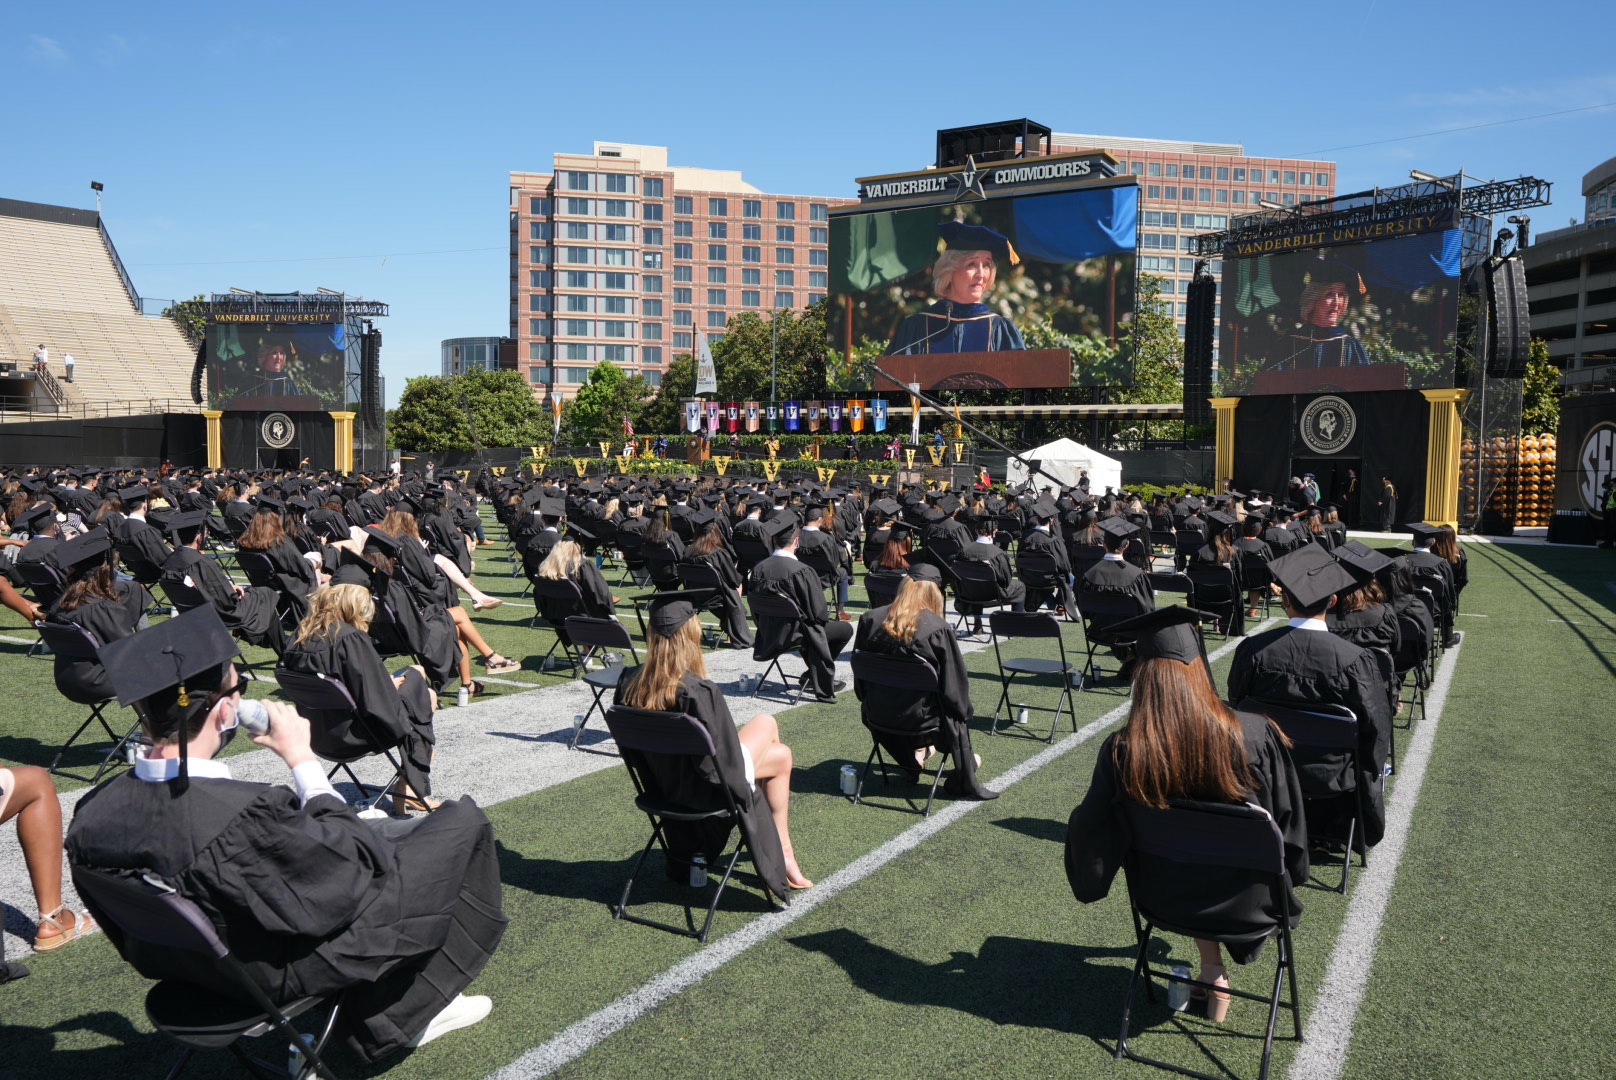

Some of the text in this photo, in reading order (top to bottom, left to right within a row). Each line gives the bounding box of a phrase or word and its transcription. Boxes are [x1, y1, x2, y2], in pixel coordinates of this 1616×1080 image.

[866, 160, 1090, 198] VANDERBILT V COMMODORES
[1236, 216, 1436, 255] VANDERBILT UNIVERSITY
[274, 314, 331, 322] UNIVERSITY
[1582, 429, 1616, 512] SE
